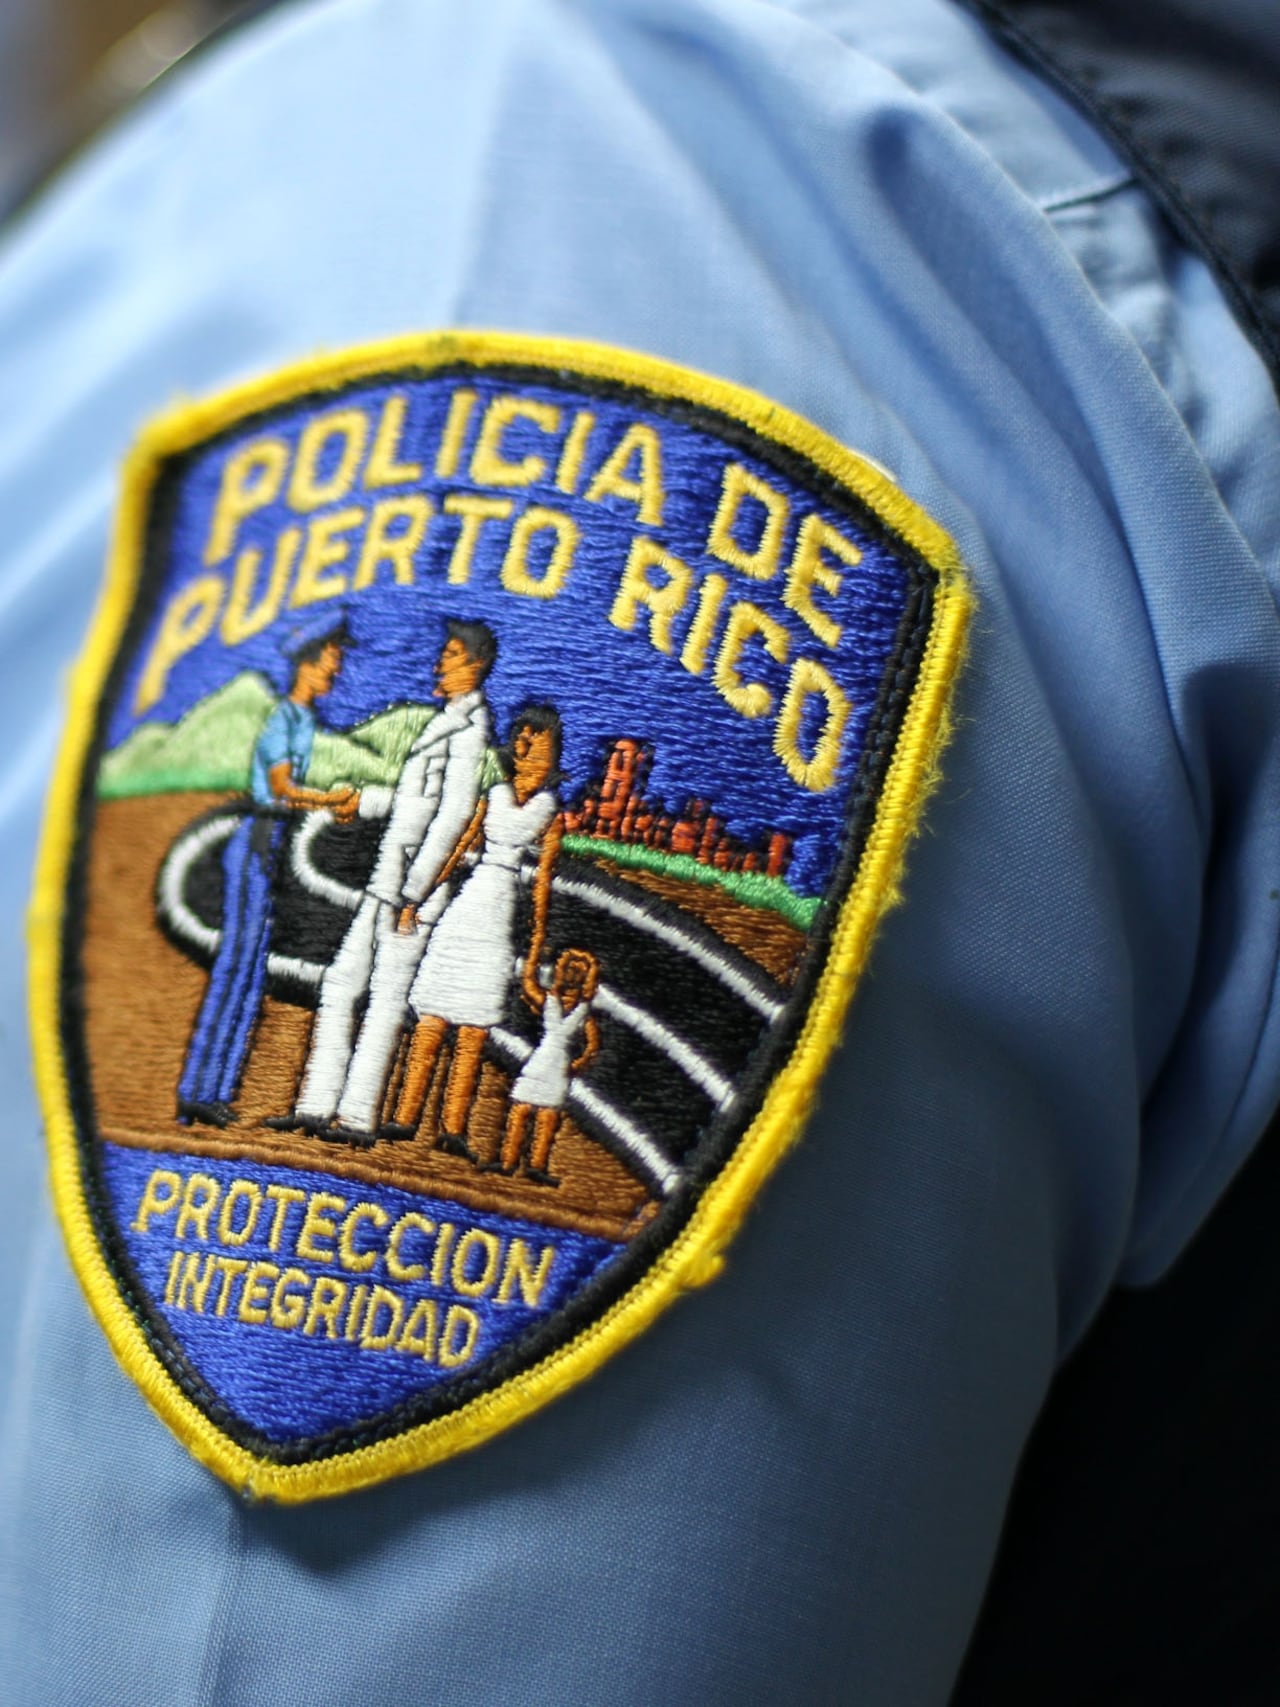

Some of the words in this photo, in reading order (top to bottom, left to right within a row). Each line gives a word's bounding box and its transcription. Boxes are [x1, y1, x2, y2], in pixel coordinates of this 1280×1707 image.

[204, 388, 666, 566] POLICIA
[708, 461, 863, 648] DE
[132, 494, 581, 717] PUERTO
[608, 537, 853, 792] RICO
[131, 1169, 555, 1307] PROTECCION
[165, 1251, 480, 1368] INTEGRIDAD
